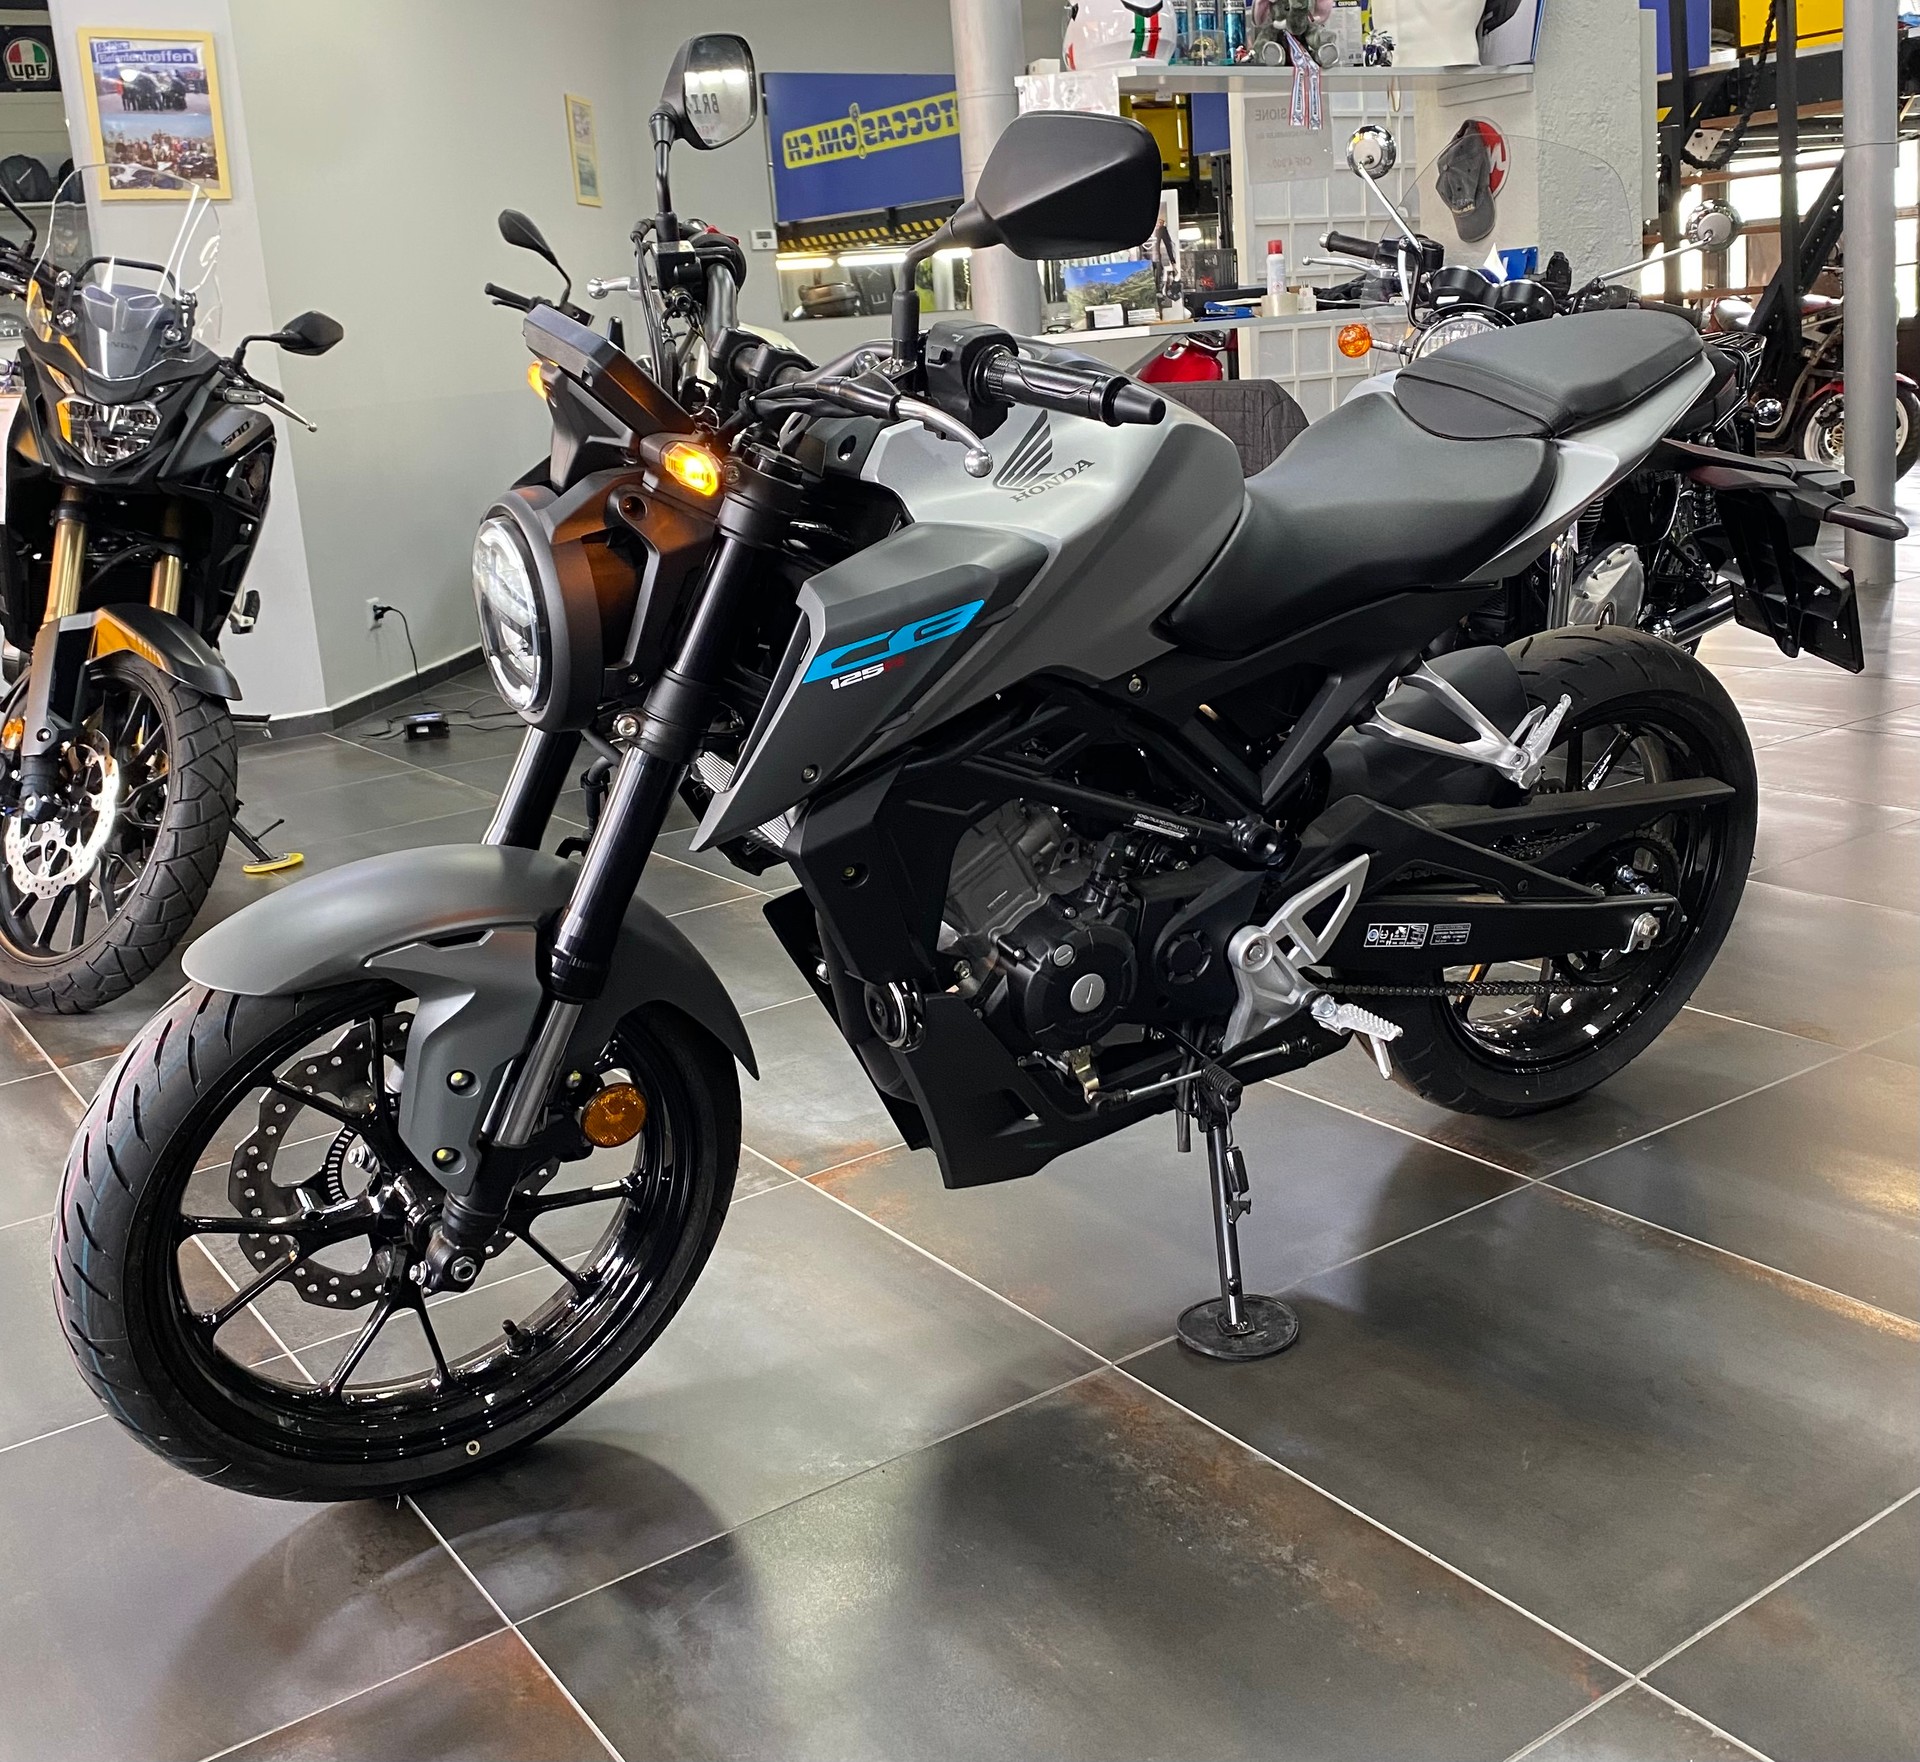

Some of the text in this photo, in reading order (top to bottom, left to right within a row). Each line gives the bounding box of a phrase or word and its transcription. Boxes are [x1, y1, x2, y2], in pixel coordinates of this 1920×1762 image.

[1010, 459, 1096, 503] HONDA
[802, 599, 985, 685] CB
[830, 655, 906, 691] 125R
